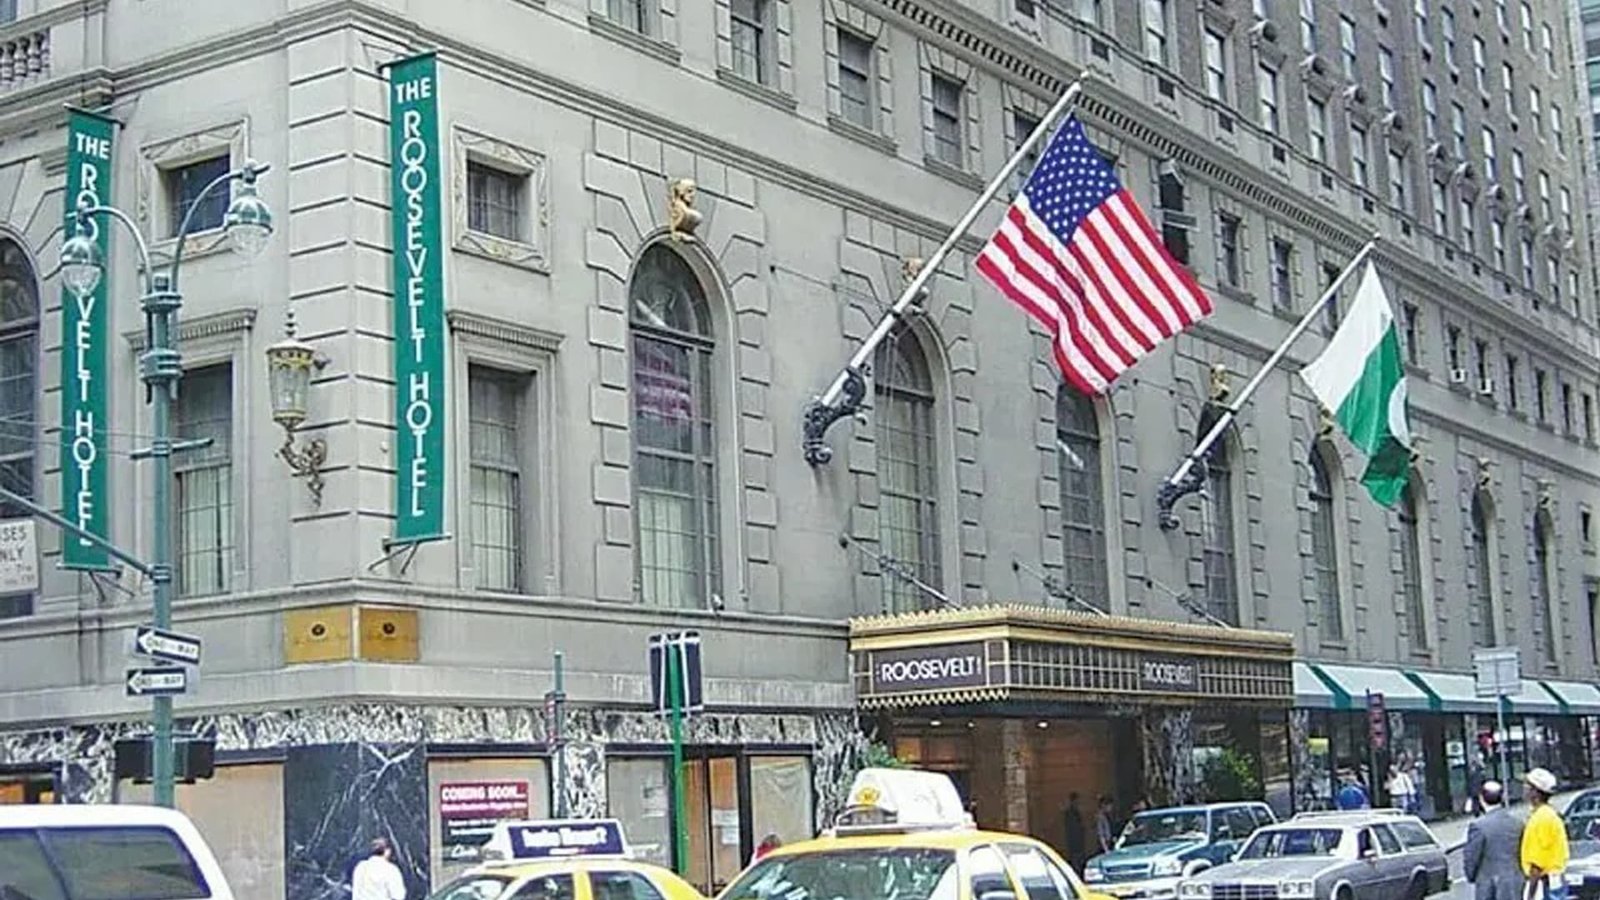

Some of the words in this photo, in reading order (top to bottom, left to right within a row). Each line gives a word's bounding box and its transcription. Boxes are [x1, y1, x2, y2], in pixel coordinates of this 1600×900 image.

[394, 77, 431, 104] THE
[75, 132, 111, 160] THE
[401, 110, 427, 363] ROOSEVELT
[406, 371, 432, 517] HOTEL
[73, 410, 96, 546] HOTEL
[881, 656, 975, 682] ROOSEVELT
[442, 786, 485, 800] COMING
